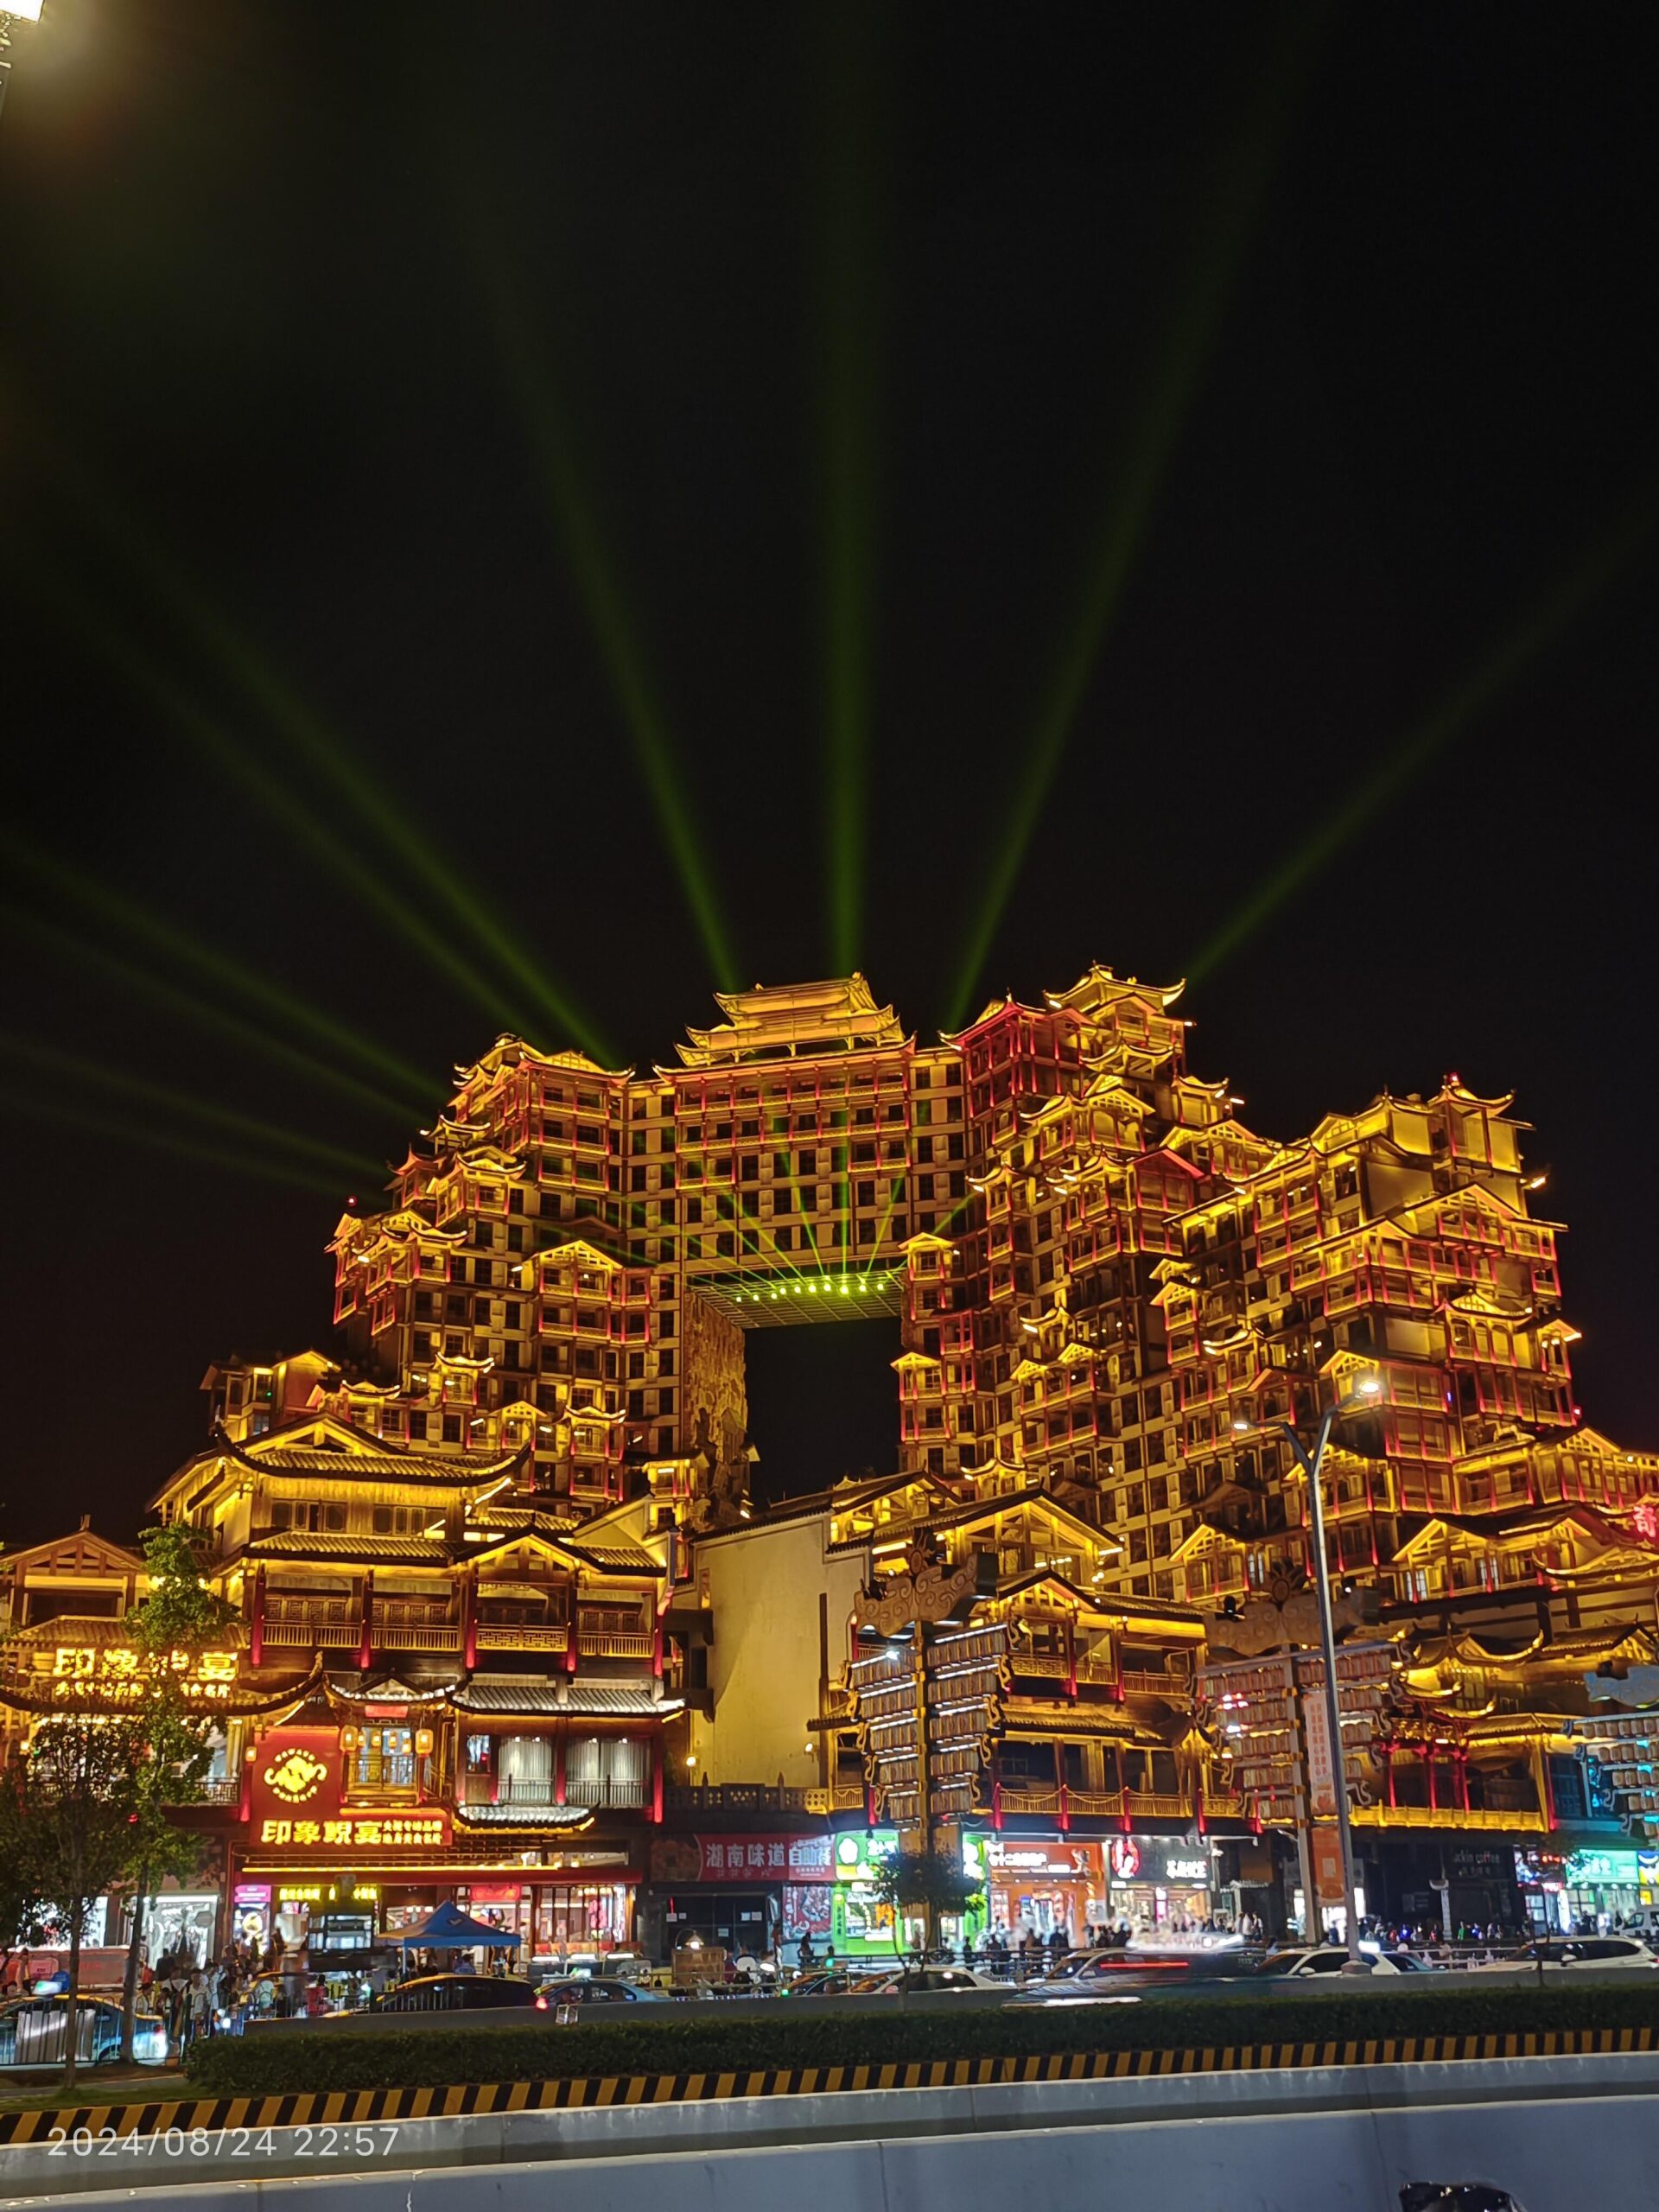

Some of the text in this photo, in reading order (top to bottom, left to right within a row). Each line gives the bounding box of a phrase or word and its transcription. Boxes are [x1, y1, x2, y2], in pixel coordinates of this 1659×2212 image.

[1633, 1504, 1656, 1537] 奇
[706, 1842, 785, 1868] 湖南味道
